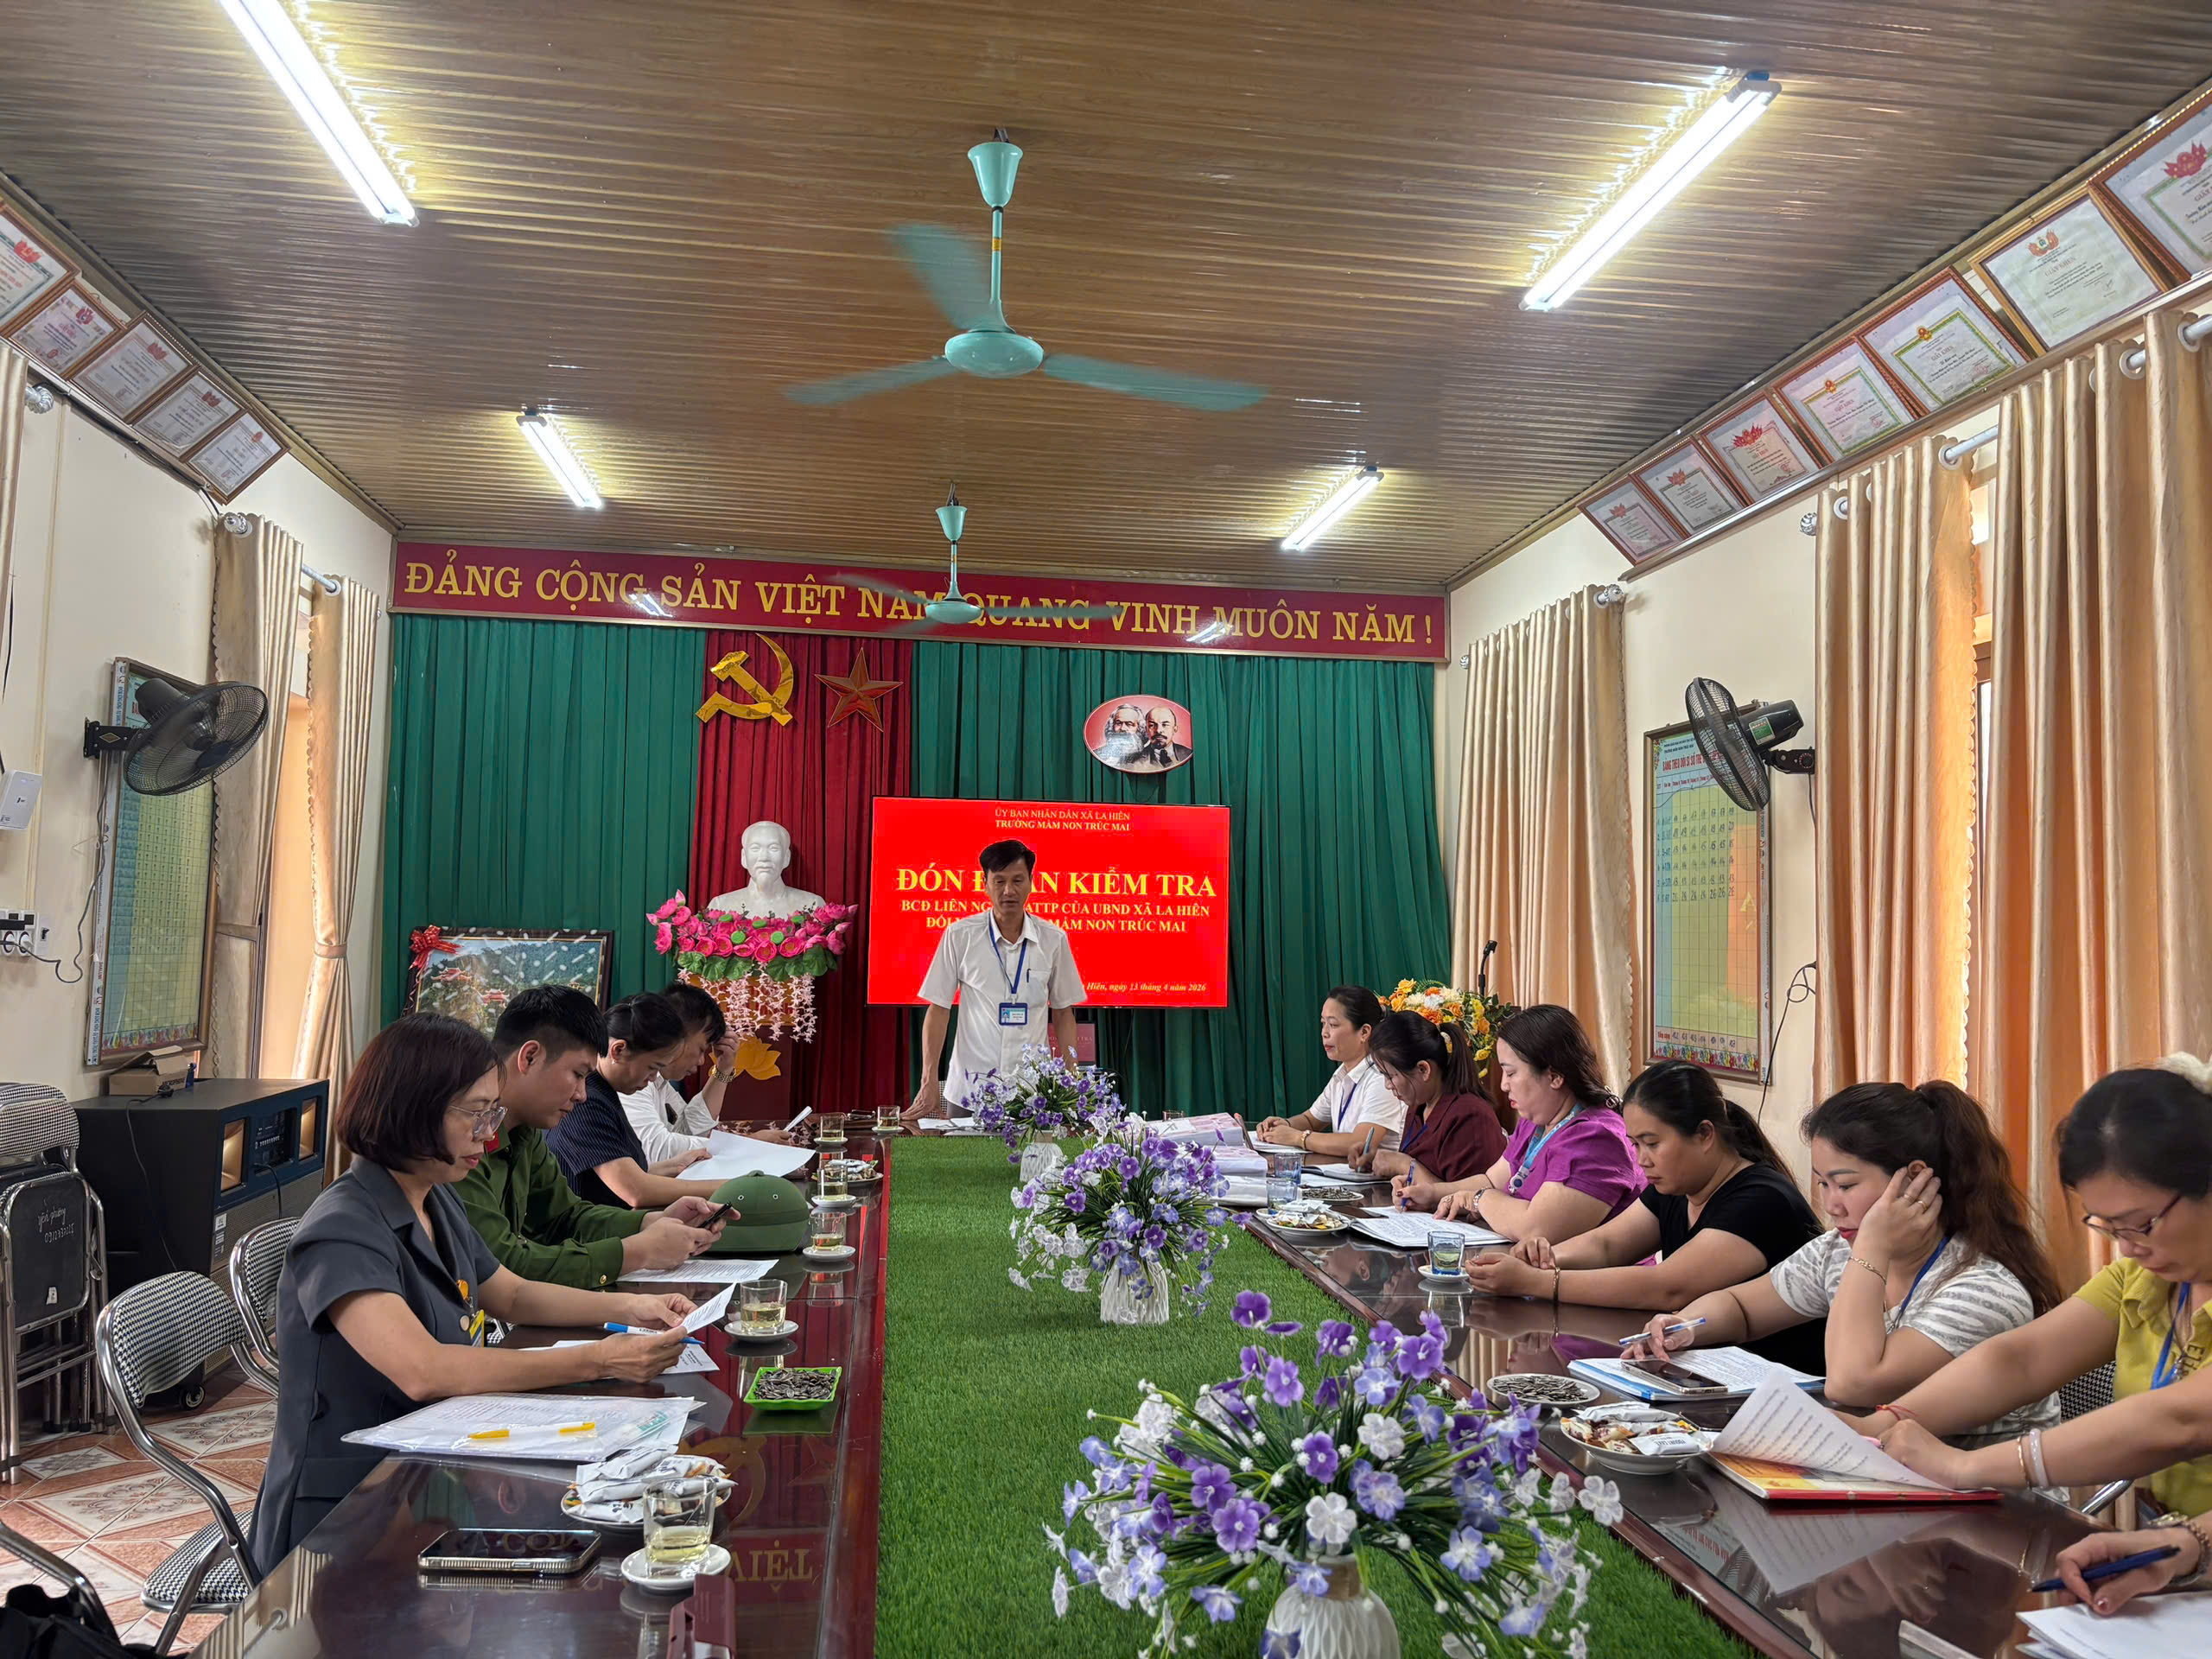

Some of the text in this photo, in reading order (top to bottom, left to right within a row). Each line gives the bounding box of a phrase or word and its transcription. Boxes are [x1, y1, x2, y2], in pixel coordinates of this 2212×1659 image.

[404, 550, 522, 598] ĐẢNG
[536, 559, 646, 611] CỘNG
[660, 563, 741, 610] SẢN
[755, 574, 844, 624] VIỆT
[968, 593, 1090, 630] QUANG
[1106, 601, 1199, 635] VINH
[1212, 599, 1319, 640] MUÔN
[1333, 604, 1414, 643] NĂM
[1010, 809, 1030, 817] BAN
[1031, 809, 1057, 818] NHÂN
[1096, 811, 1107, 820] LA
[1062, 822, 1082, 830] NON
[1111, 823, 1130, 831] MAI
[896, 862, 965, 892] ĐÓN
[1069, 866, 1148, 895] KIỂM
[1156, 874, 1217, 897] TRA
[901, 899, 931, 912] BCĐ
[934, 898, 969, 912] LIÊN
[1061, 899, 1090, 914] CỦA
[1093, 904, 1130, 915] UBND
[1133, 901, 1154, 916] XÃ
[1156, 905, 1174, 916] LA
[1177, 902, 1211, 917] HIÊN
[1086, 919, 1116, 931] NON
[1118, 918, 1156, 932] TRÚC
[1159, 920, 1186, 932] MAI
[1188, 983, 1207, 992] 2026
